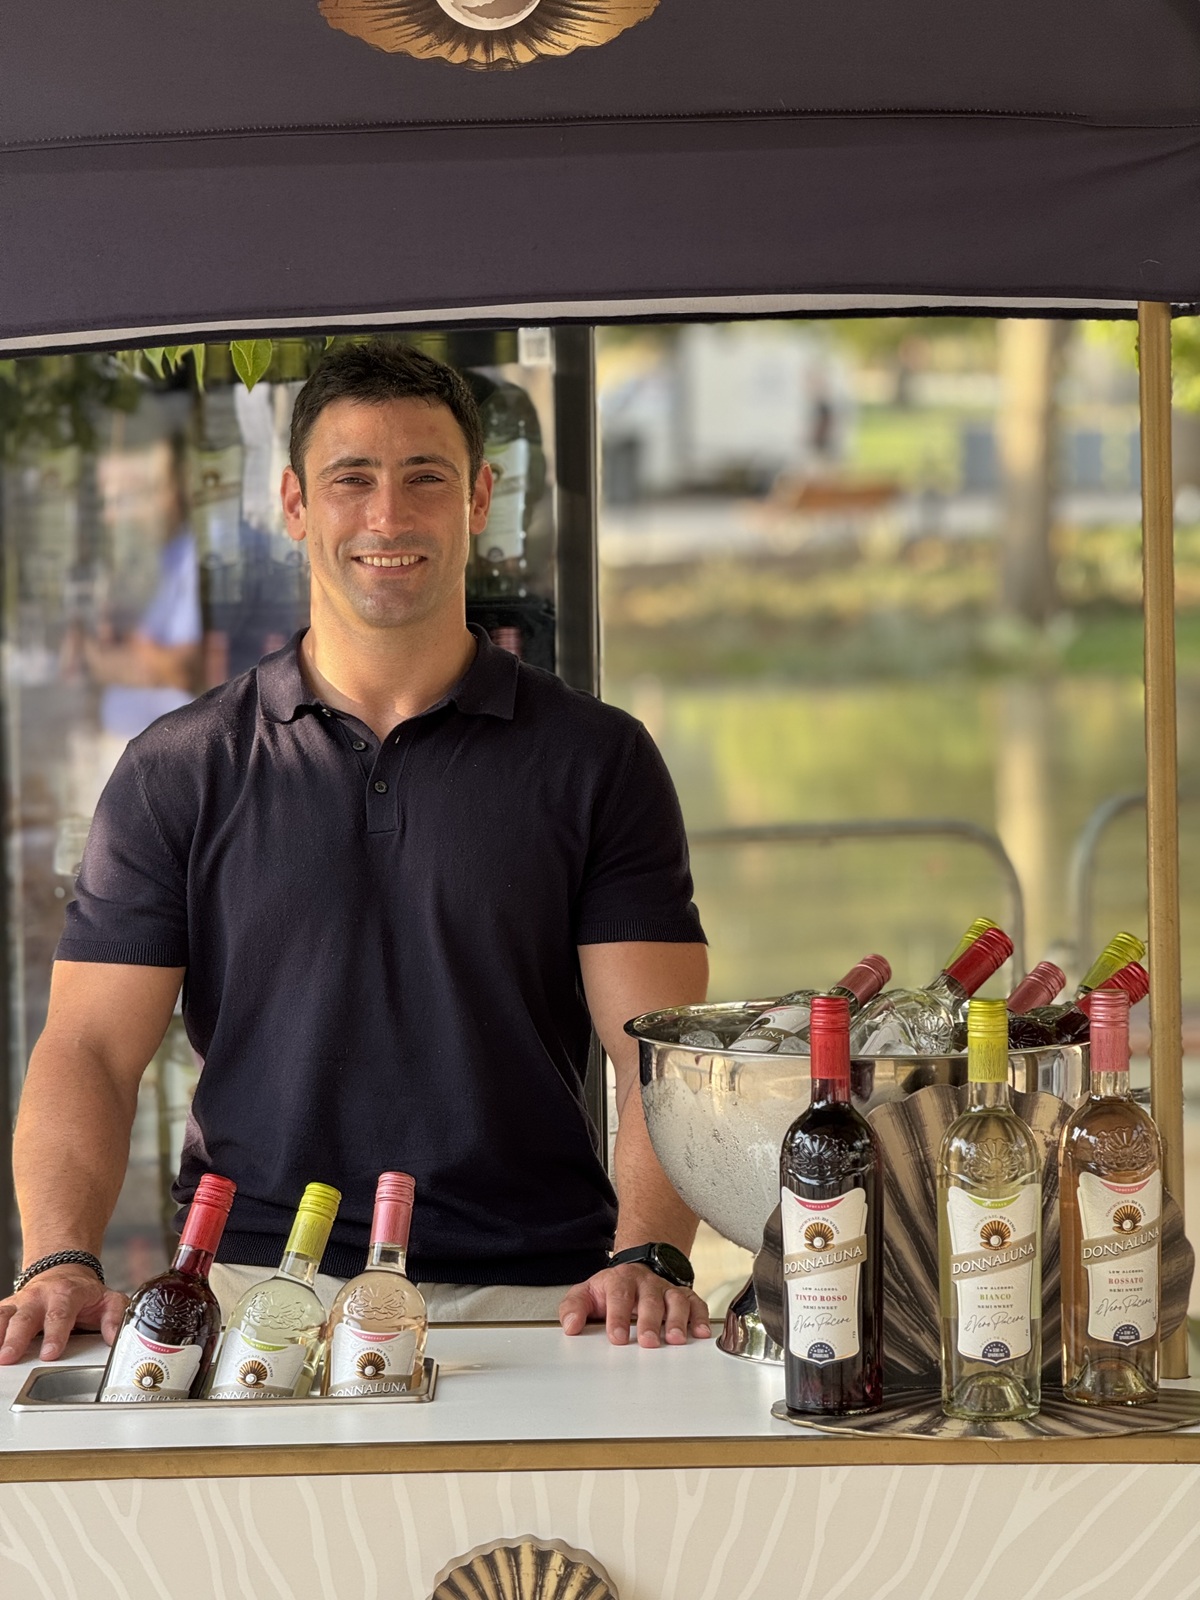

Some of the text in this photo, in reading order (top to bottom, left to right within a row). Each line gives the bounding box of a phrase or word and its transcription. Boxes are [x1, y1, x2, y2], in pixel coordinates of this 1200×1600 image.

[1083, 1226, 1160, 1260] DONNALUNA
[784, 1245, 863, 1275] DONNALUNA
[952, 1242, 1035, 1275] DONNALUNA
[1108, 1277, 1144, 1285] ROSSATO
[795, 1294, 818, 1302] TINTO
[980, 1293, 1012, 1301] BIANCO
